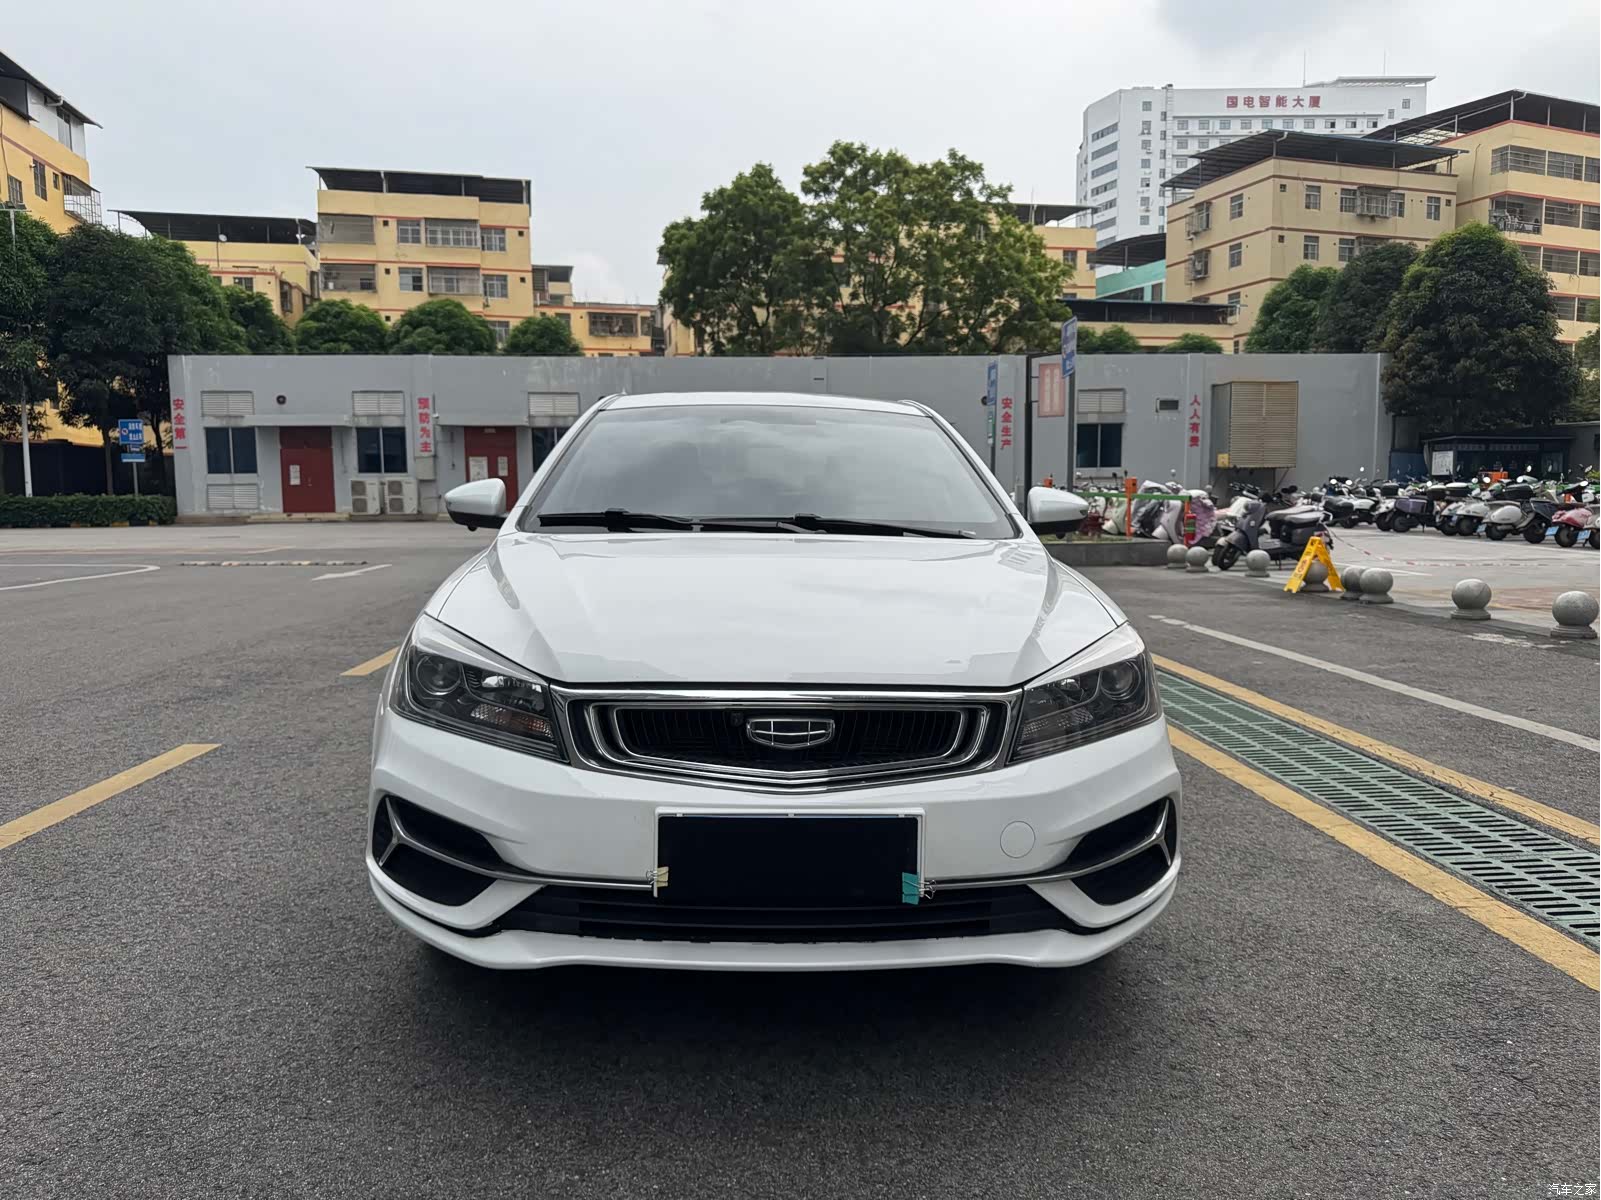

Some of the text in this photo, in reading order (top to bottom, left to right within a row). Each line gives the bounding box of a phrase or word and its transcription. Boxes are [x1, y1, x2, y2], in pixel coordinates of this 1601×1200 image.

[1226, 95, 1321, 109] 国电智能大厦
[172, 398, 187, 450] 安全第一
[417, 397, 432, 453] 预防为主
[1001, 397, 1013, 450] 安全生产
